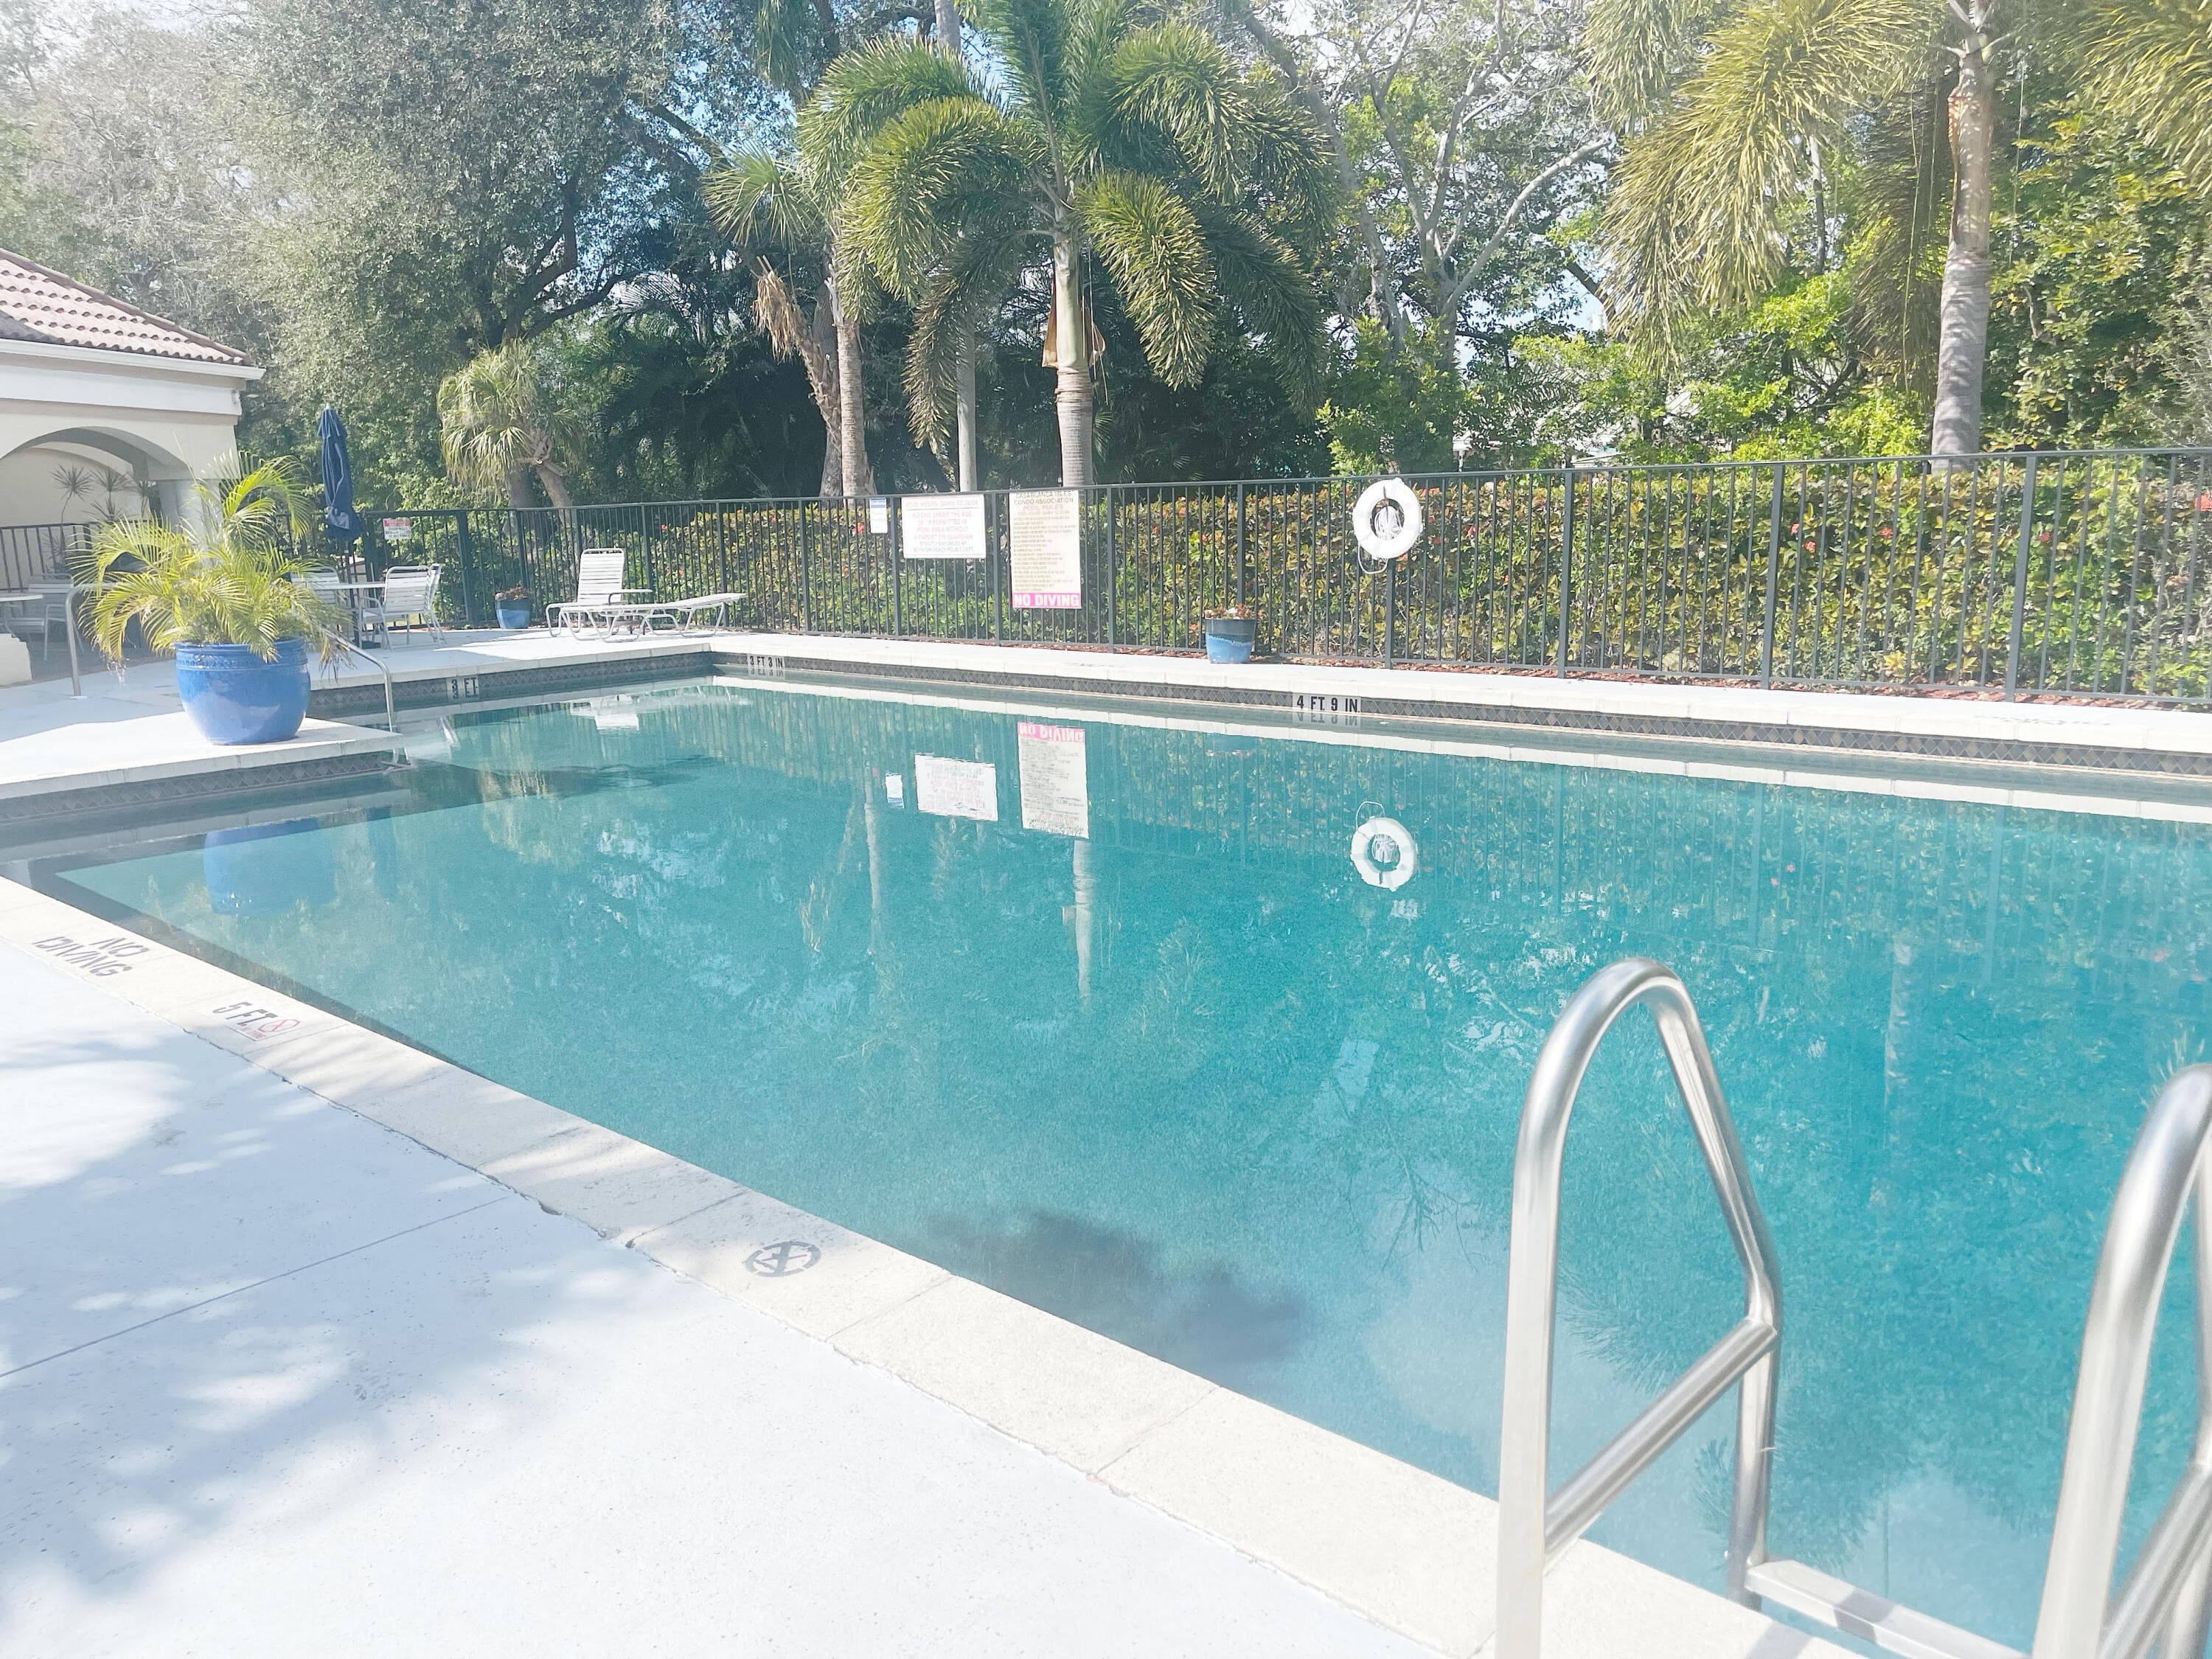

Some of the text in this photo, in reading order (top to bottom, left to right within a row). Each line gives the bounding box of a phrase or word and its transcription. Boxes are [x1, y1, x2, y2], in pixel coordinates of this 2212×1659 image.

[1013, 594, 1079, 606] NO DIVING
[749, 655, 783, 667] 3 FT 3 IN
[1297, 695, 1304, 709] 4
[1331, 698, 1338, 711] 9
[88, 937, 150, 957] NO
[32, 936, 133, 976] DIVING
